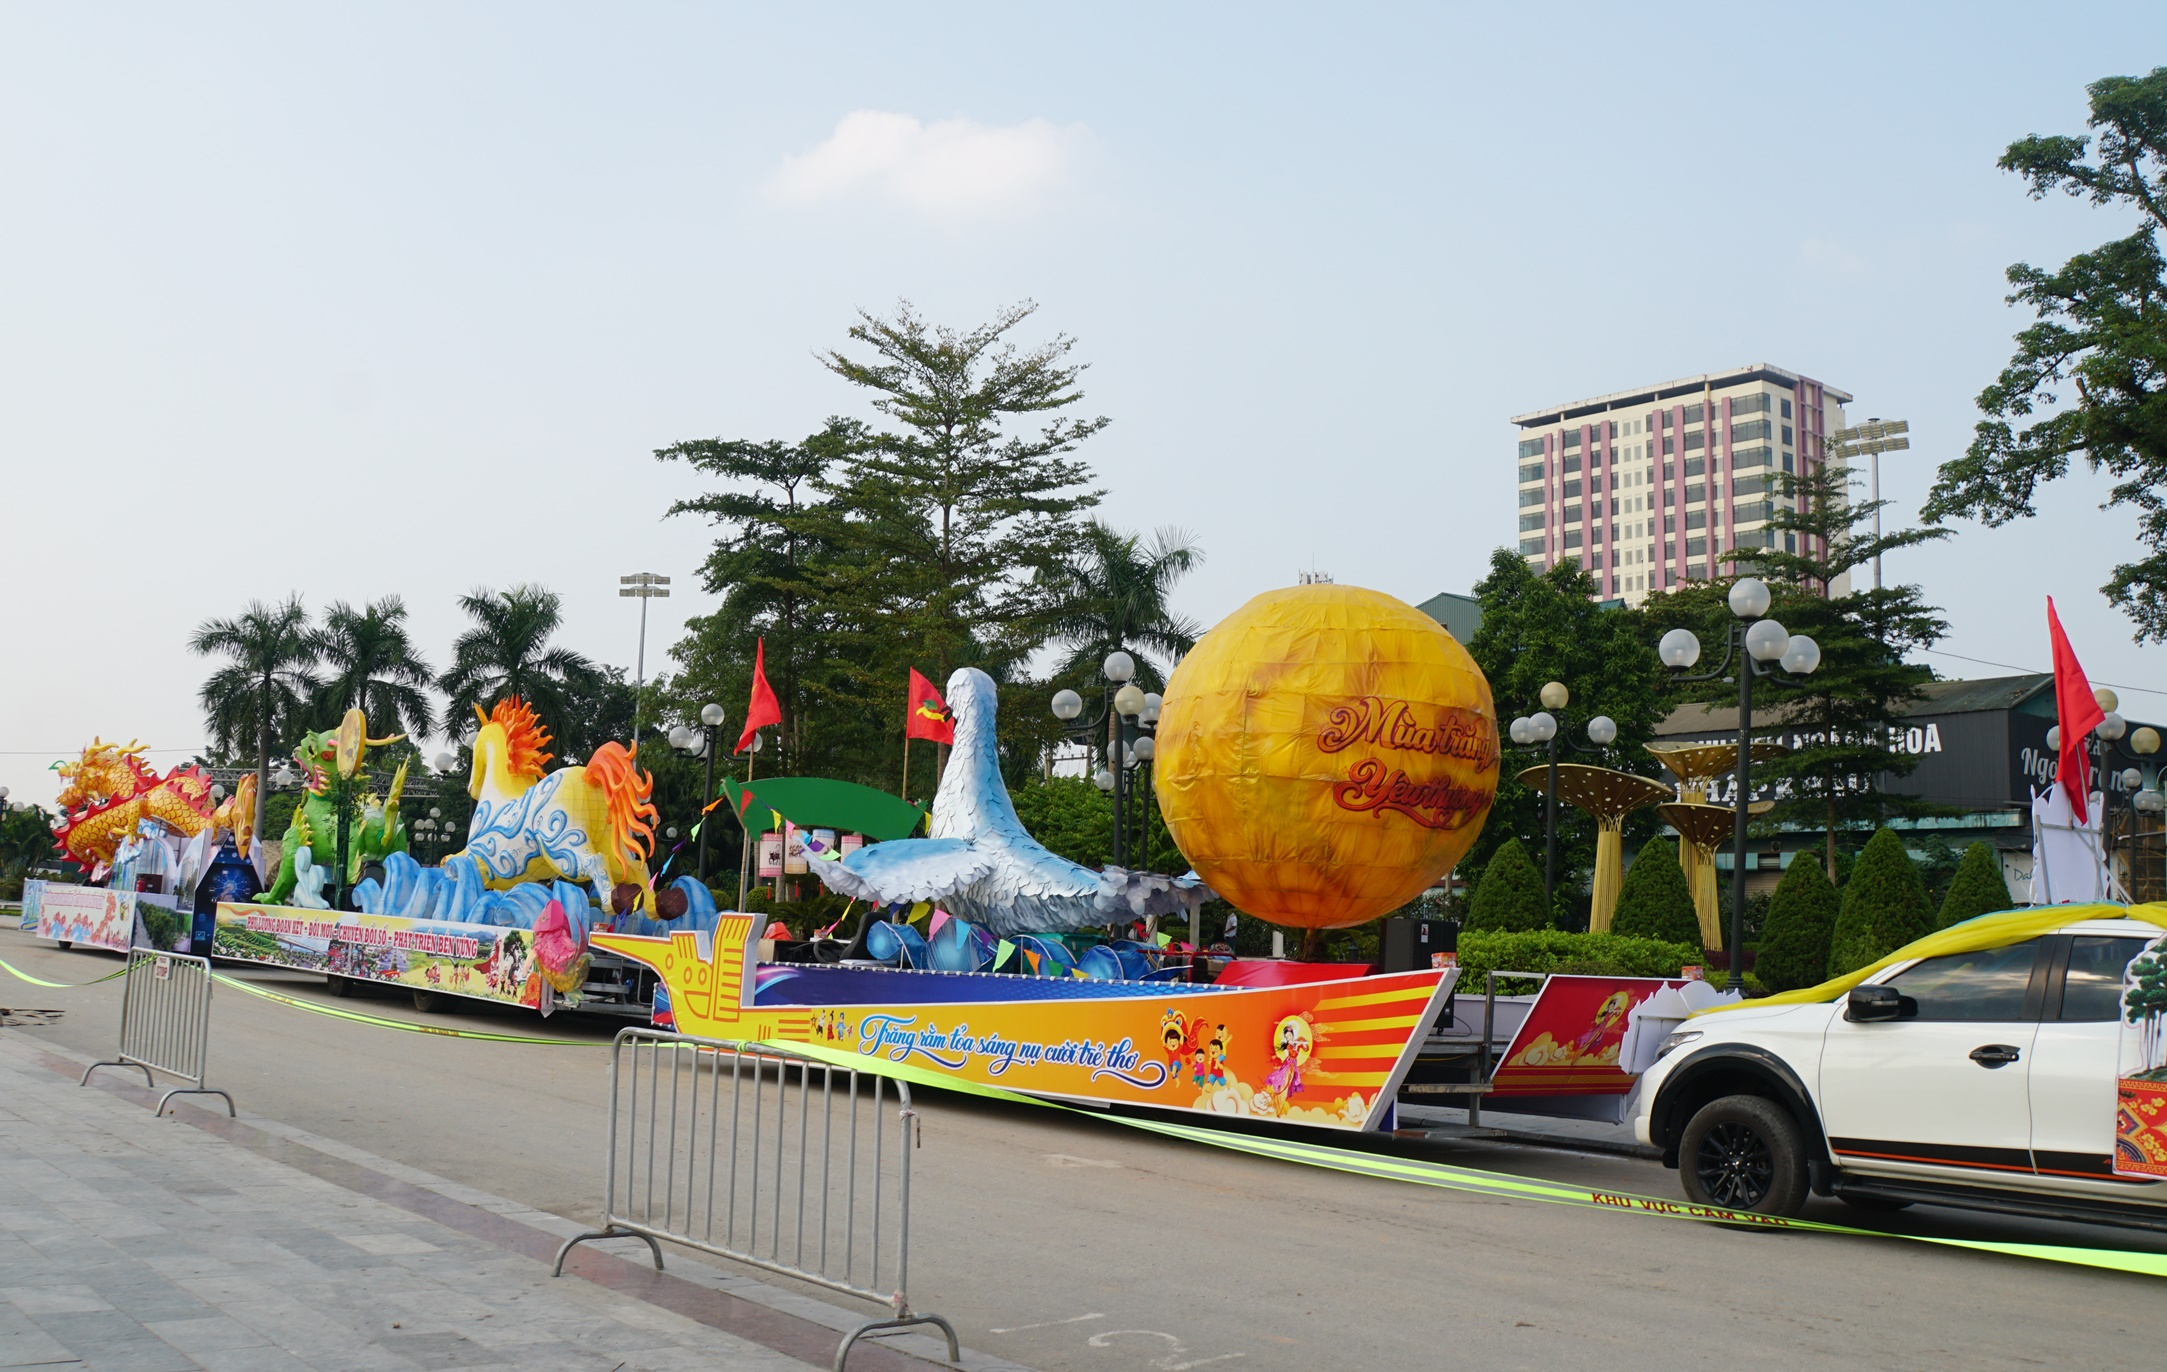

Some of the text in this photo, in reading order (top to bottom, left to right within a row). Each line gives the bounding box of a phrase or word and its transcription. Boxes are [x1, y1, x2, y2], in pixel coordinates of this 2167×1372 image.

[1317, 696, 1497, 774] Mùa trăng
[1888, 723, 1942, 755] HOA
[1333, 757, 1425, 812] Yêu
[2021, 747, 2059, 786] Ngọ
[276, 917, 291, 934] ĐOÀN
[292, 916, 304, 936] KẾT
[308, 916, 320, 937] ĐỔI
[321, 920, 333, 939] MỚI
[338, 921, 363, 943] CHUYỂN
[365, 922, 377, 943] ĐỔI
[378, 923, 388, 945] SỐ
[393, 929, 413, 950] PHÁT
[415, 926, 437, 952] TRIỂN
[438, 929, 454, 955] BỀN
[456, 933, 477, 958] VỮNG
[860, 1014, 1142, 1075] Trăng rằm tỏa sáng nụ cười trẻ thơ
[1591, 1192, 1632, 1208] KHU
[1638, 1199, 1681, 1214] VỰC
